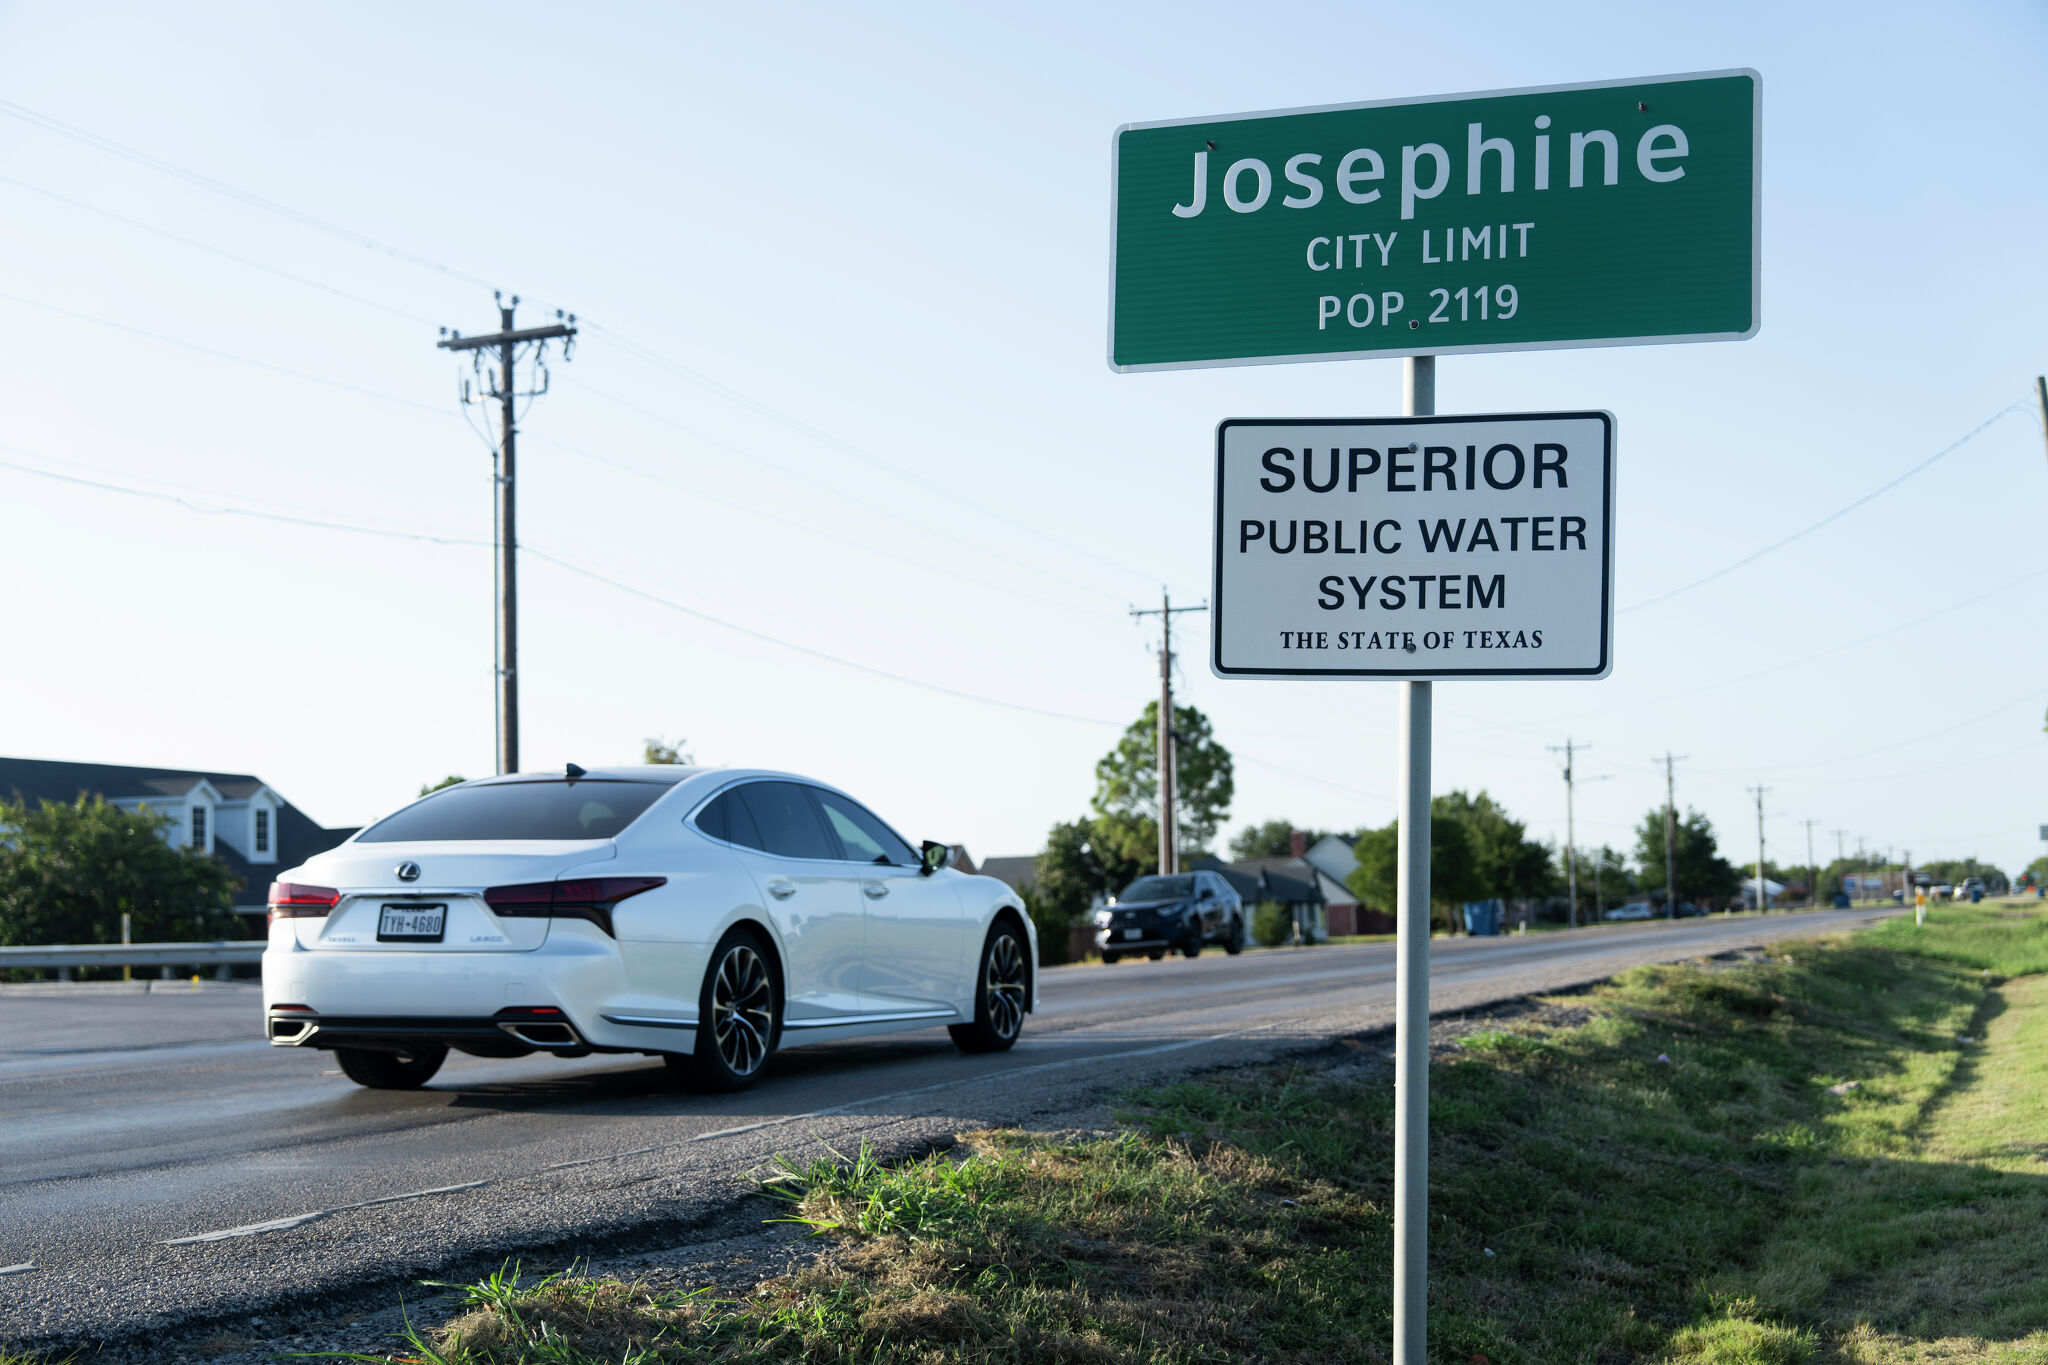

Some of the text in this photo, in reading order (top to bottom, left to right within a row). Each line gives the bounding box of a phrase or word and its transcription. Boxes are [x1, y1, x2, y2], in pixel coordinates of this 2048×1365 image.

[1171, 115, 1689, 220] Josephine
[1307, 223, 1535, 271] CITY LIMIT
[1429, 284, 1518, 323] 2119
[1260, 443, 1568, 493] SUPERIOR
[1240, 516, 1587, 554] PUBLIC WATER
[1318, 574, 1505, 610] SYSTEM
[1280, 630, 1543, 650] THE STATE OF TEXAS
